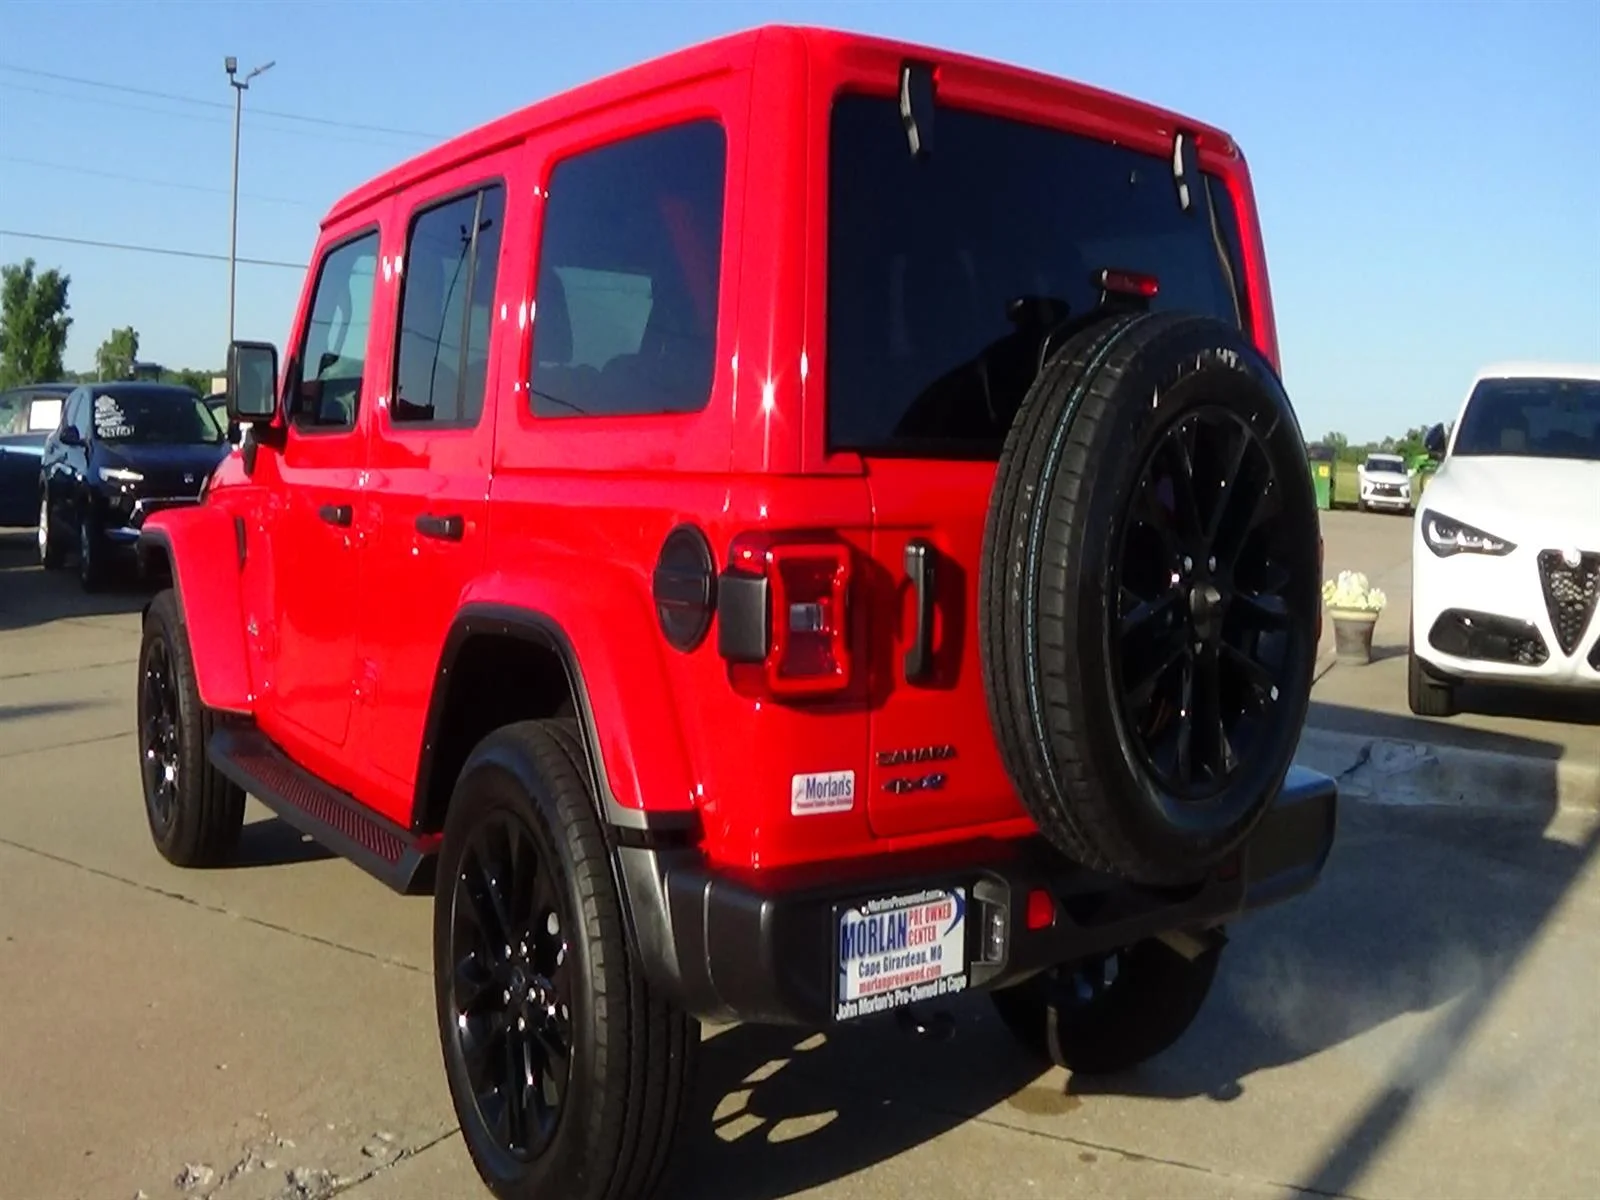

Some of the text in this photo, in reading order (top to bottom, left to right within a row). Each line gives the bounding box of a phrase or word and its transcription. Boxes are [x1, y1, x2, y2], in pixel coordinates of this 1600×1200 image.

[806, 774, 852, 799] Morlan's
[908, 901, 952, 926] PRE OWNED
[842, 912, 907, 960] MORLAN
[908, 926, 937, 947] CENTER
[859, 960, 880, 978] Cape
[930, 945, 942, 961] MO
[836, 1002, 857, 1021] John
[894, 980, 938, 1006] Pre-Owned
[947, 975, 967, 993] Cape
